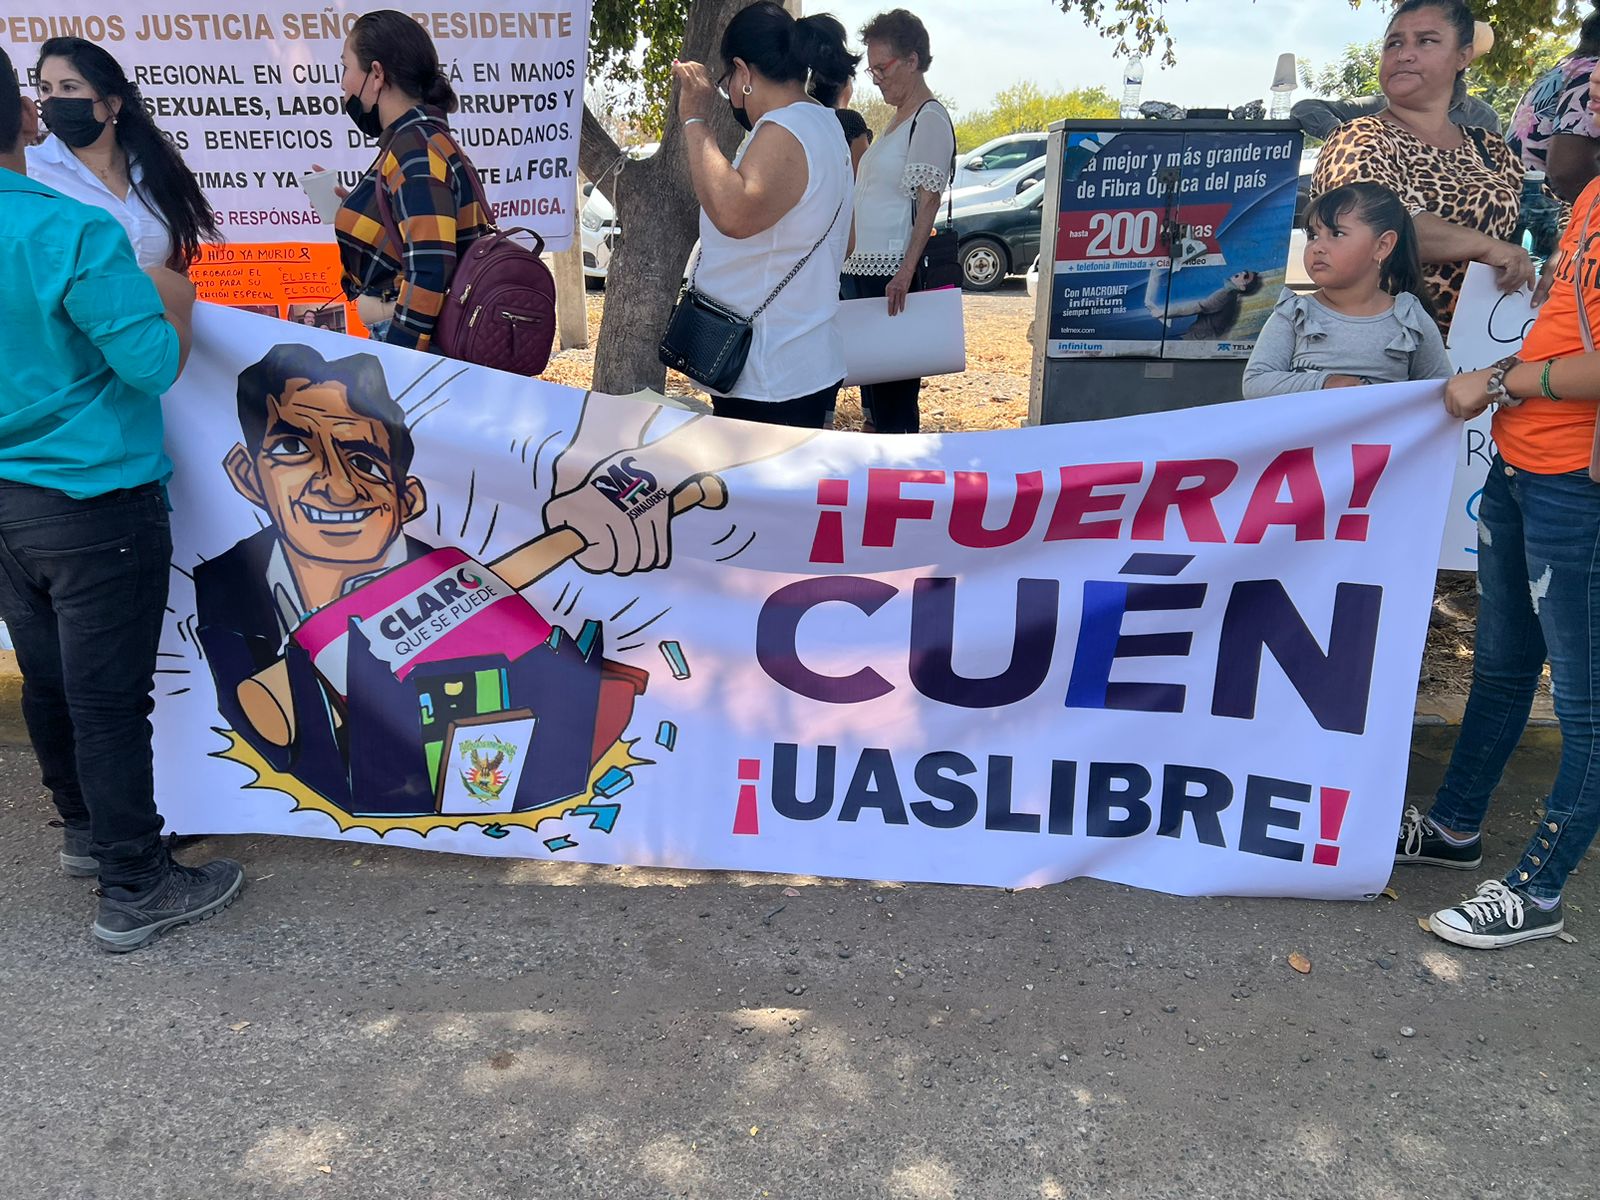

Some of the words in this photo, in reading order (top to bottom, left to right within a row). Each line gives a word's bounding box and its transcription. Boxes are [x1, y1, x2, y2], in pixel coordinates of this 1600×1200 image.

[135, 13, 274, 41] JUSTICIA
[134, 65, 245, 85] REGIONAL
[253, 65, 282, 84] EN
[473, 63, 500, 83] EN
[511, 59, 575, 83] MANOS
[145, 97, 271, 119] SEXUALES,
[564, 89, 574, 108] Y
[205, 130, 332, 149] BENEFICIOS
[1102, 151, 1148, 174] mejor
[1152, 153, 1162, 172] y
[1166, 147, 1202, 167] más
[1206, 143, 1261, 168] grande
[1265, 140, 1293, 160] red
[253, 172, 266, 188] Y
[273, 171, 299, 188] YA
[506, 167, 522, 184] LA
[527, 157, 572, 181] FGR.
[1076, 181, 1096, 199] de
[1101, 179, 1141, 198] Fibra
[1204, 171, 1230, 191] del
[1233, 169, 1267, 193] país
[491, 197, 566, 219] BENDIGA.
[1069, 230, 1089, 238] hasta
[1085, 211, 1158, 257] 200
[208, 250, 235, 261] HIJO
[240, 250, 253, 260] YA
[258, 249, 295, 260] MURIO
[1112, 259, 1147, 270] ilimitada
[1064, 288, 1080, 298] Con
[1082, 285, 1128, 297] MACRONET
[1069, 298, 1123, 308] infinitum
[1062, 308, 1090, 317] siempre
[1091, 307, 1111, 316] tienes
[1113, 305, 1127, 314] más
[1060, 327, 1096, 335] telmex.com
[1058, 342, 1103, 350] infinitum
[808, 444, 1391, 563] ¡FUERA!
[380, 567, 483, 641] CLARO
[395, 626, 432, 656] QUE
[431, 611, 452, 633] SE
[450, 585, 498, 619] PUEDE
[756, 553, 1383, 735] CUÉN
[732, 742, 1350, 867] ¡UASLIBRE!
